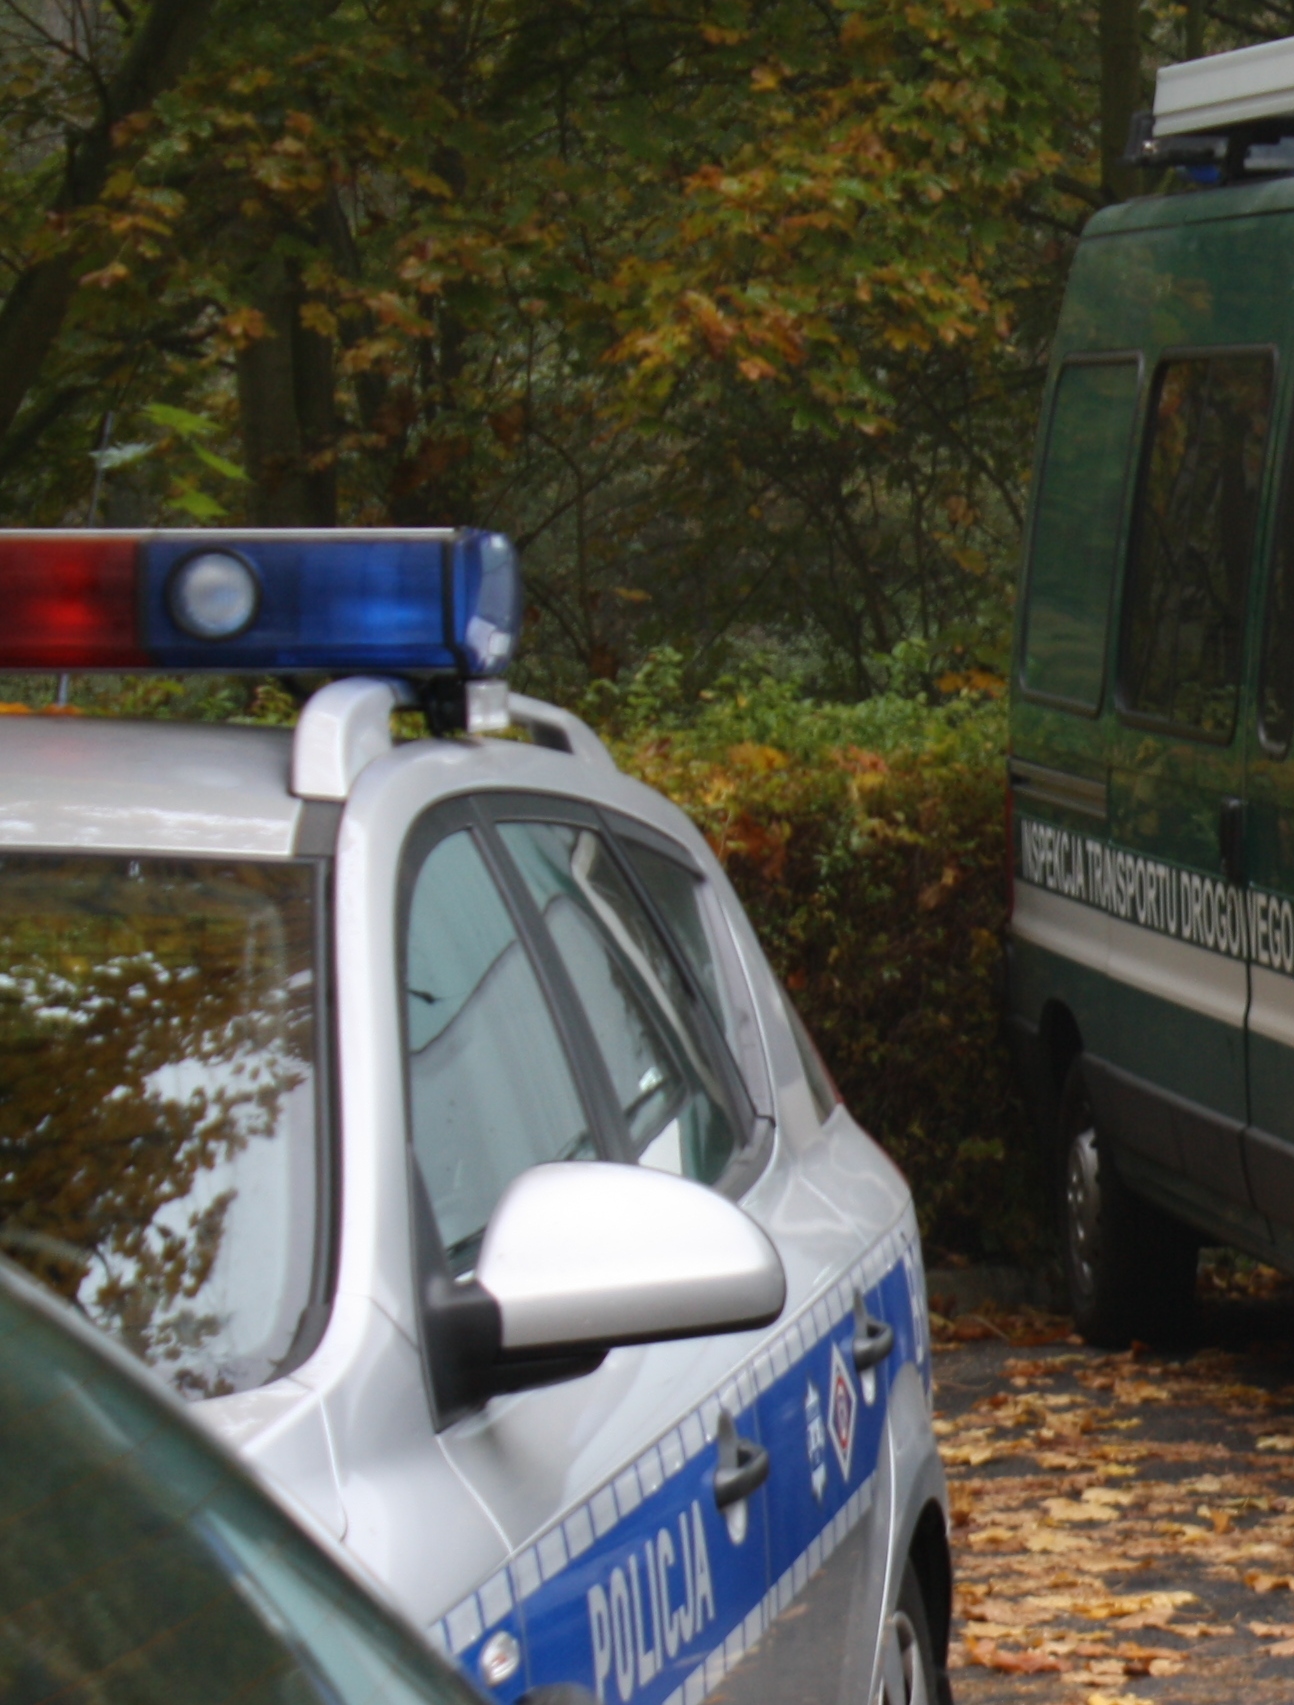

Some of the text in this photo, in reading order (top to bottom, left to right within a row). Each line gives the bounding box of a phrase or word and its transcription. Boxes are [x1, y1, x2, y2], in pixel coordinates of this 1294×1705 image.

[1021, 818, 1086, 899] INSPEKCJA
[1085, 838, 1178, 935] TRANSPORTU
[588, 1499, 716, 1705] POLICJA
